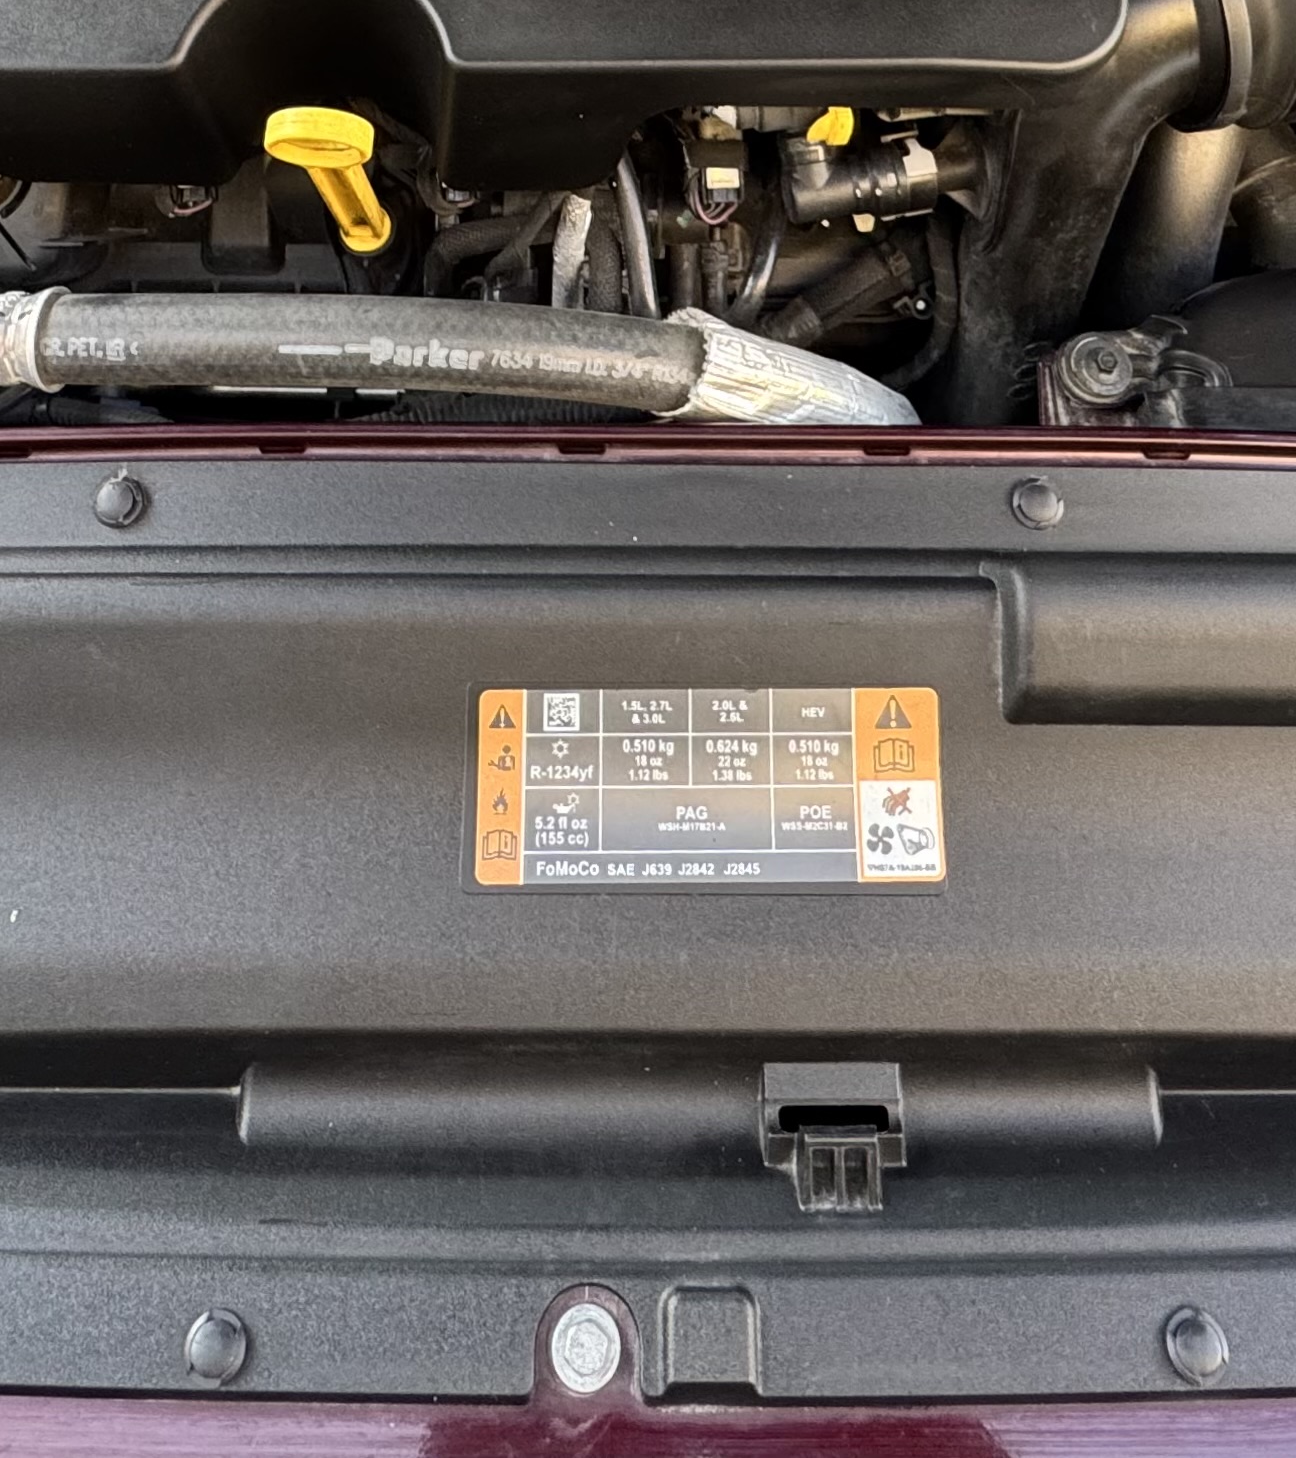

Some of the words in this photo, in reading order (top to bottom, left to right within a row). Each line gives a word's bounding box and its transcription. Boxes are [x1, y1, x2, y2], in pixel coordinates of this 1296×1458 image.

[369, 336, 485, 370] Parker
[491, 349, 534, 370] 7634
[649, 700, 673, 712] 2.7L
[712, 700, 736, 711] 2.0L
[800, 706, 826, 718] HEV
[622, 739, 655, 753] 0.510
[658, 739, 675, 756] kg
[706, 739, 739, 753] 0.624
[742, 739, 758, 756] kg
[788, 739, 821, 753] 0.510
[823, 739, 840, 756] kg
[634, 755, 647, 766] 18
[650, 756, 662, 766] oz
[718, 756, 730, 768] 22
[733, 757, 746, 768] oz
[802, 756, 814, 766] 18
[815, 757, 828, 766] oz
[530, 765, 594, 782] R-1234yf
[628, 769, 650, 782] 1.12
[652, 769, 669, 781] lbs
[736, 769, 752, 781] lbs
[794, 768, 816, 781] 1.12
[818, 768, 834, 781] lbs
[676, 806, 708, 820] PAG
[800, 805, 832, 819] POE
[535, 816, 555, 830] 5.2
[558, 816, 568, 830] fl
[571, 818, 588, 830] oz
[535, 831, 564, 848] (155
[567, 831, 590, 848] cc)
[536, 861, 600, 876] FoMoCo
[607, 864, 635, 876] SAE
[642, 863, 672, 876] J639
[678, 862, 715, 876] J2842
[724, 862, 761, 876] J2845
